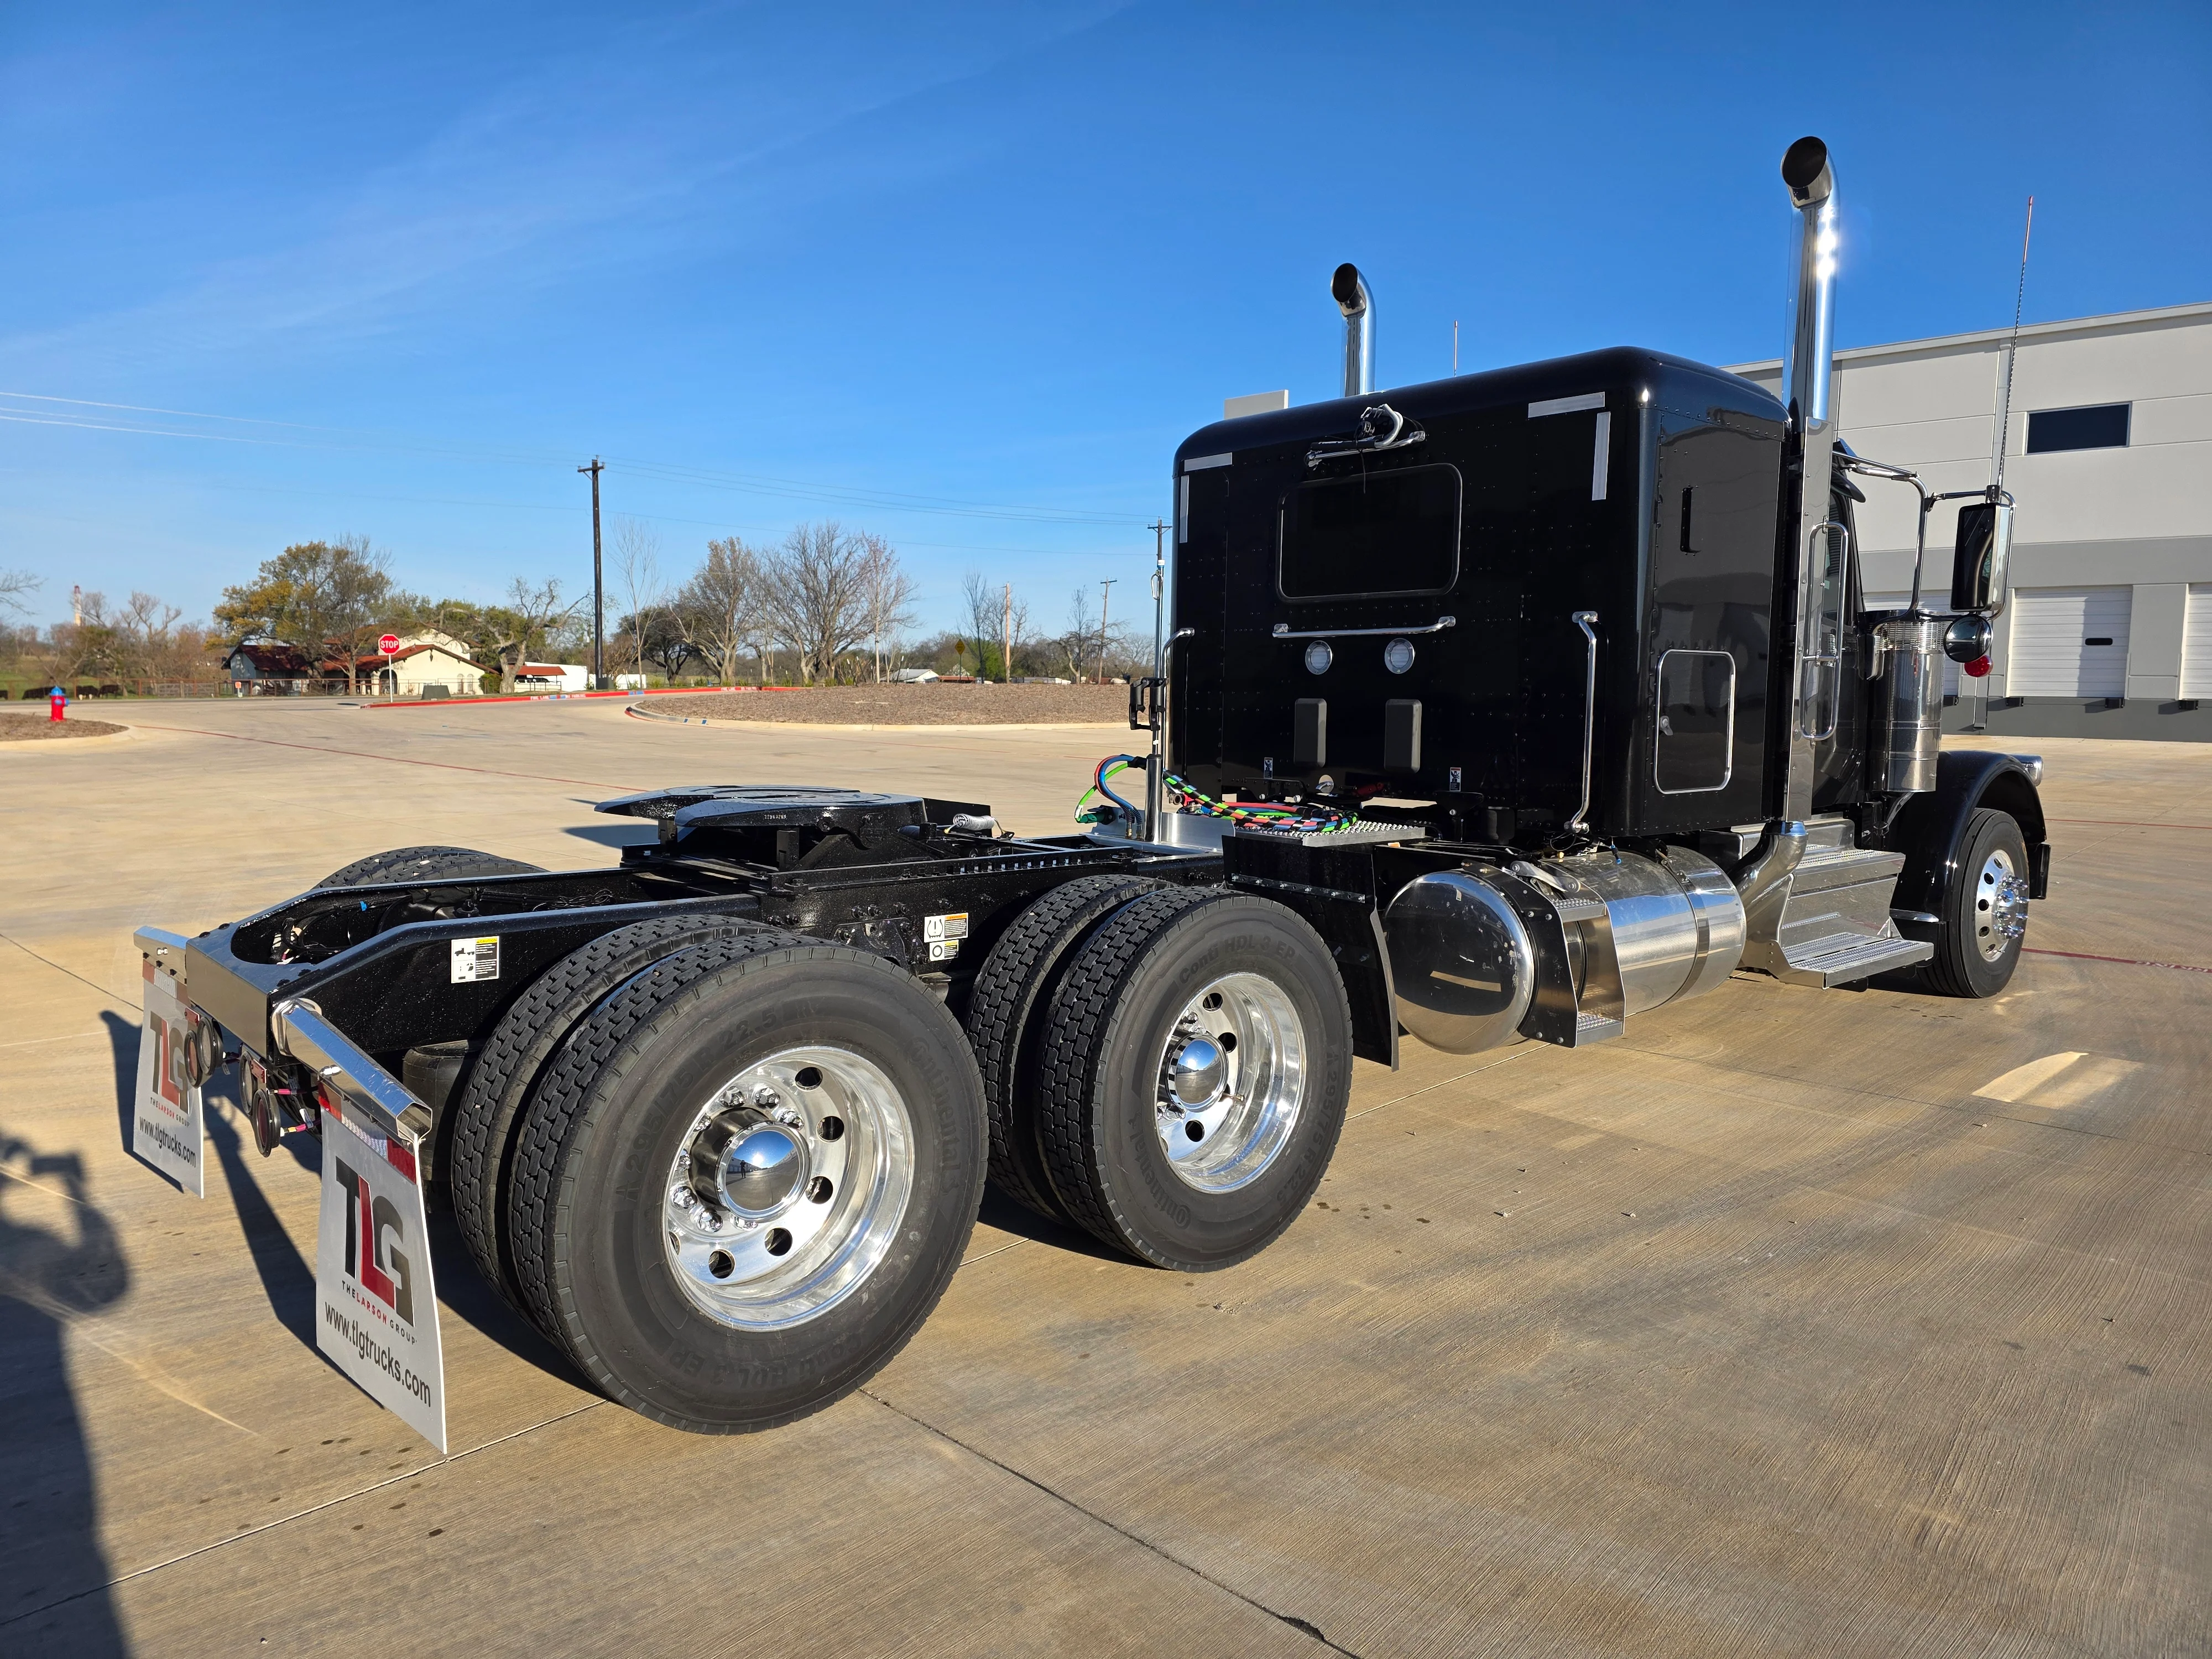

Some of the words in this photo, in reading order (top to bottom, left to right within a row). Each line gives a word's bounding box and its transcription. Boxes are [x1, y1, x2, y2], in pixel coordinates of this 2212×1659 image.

[380, 640, 398, 649] STOP
[1179, 942, 1219, 984] Conti
[1223, 935, 1254, 953] HDL
[1262, 935, 1271, 951] 3
[1275, 941, 1296, 960] EP
[150, 1011, 190, 1115] TLG
[625, 1067, 694, 1174] 295/75
[721, 1011, 776, 1050] 22.5
[176, 1114, 190, 1127] GROUP
[905, 1036, 961, 1171] Continental
[1312, 1070, 1338, 1146] 295/75
[139, 1116, 196, 1168] www.tlgtrucks.com
[1129, 1132, 1191, 1230] Continental
[1276, 1164, 1306, 1207] 22.5
[336, 1155, 415, 1327] TLG
[342, 1280, 356, 1299] THE
[356, 1292, 387, 1325] LARSON
[390, 1319, 415, 1345] GROUP
[325, 1301, 431, 1407] www.tlgtrucks.com
[669, 1350, 706, 1377] EP
